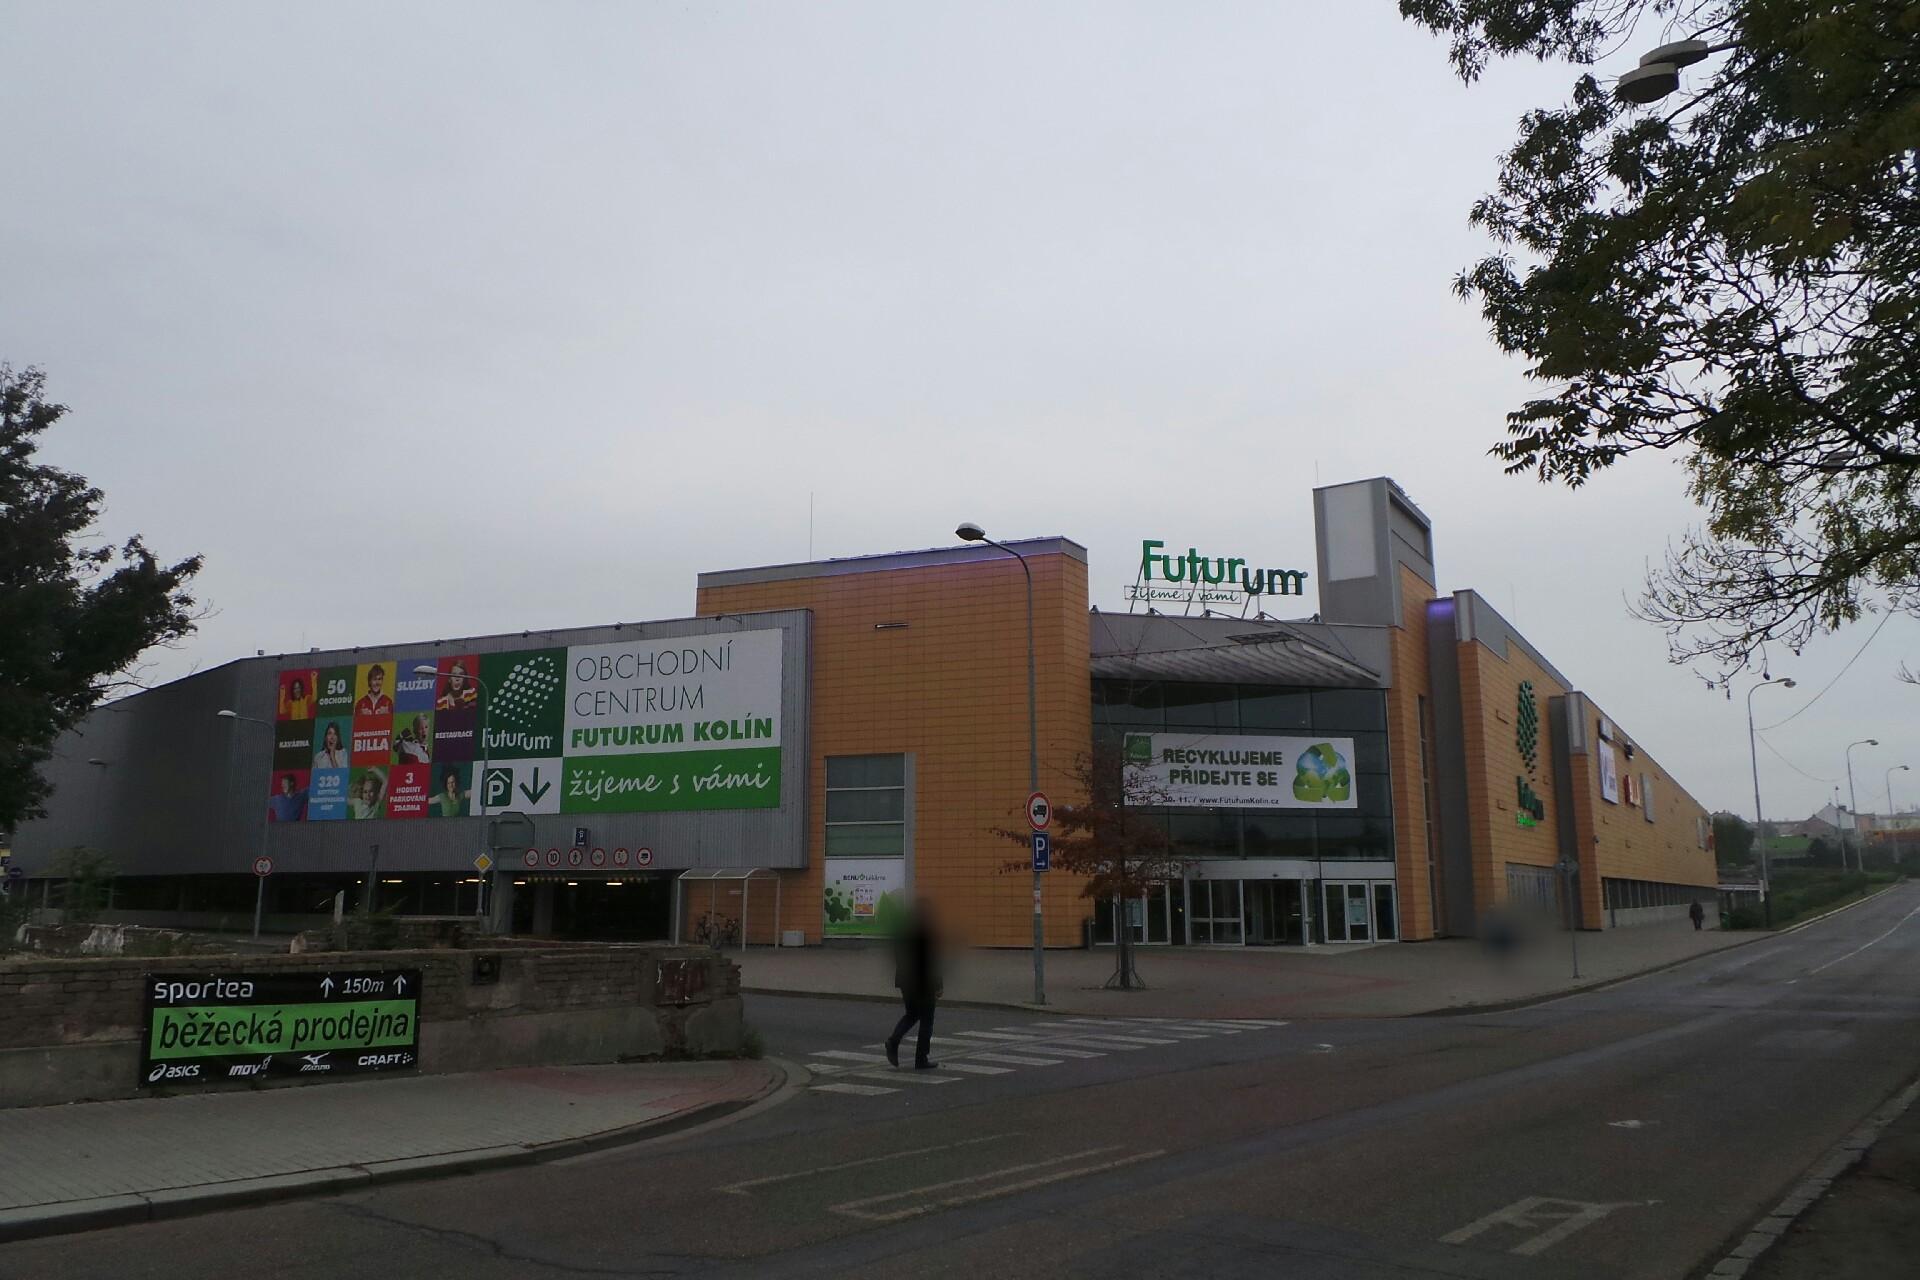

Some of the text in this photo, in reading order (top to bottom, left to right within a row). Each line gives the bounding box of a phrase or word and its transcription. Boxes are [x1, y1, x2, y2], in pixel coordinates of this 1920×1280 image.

[1143, 540, 1303, 595] Futurum
[1130, 585, 1182, 602] žijeme
[1198, 588, 1239, 602] vámi
[576, 640, 733, 681] OBCHODNÍ
[327, 680, 346, 694] 50
[397, 678, 435, 691] SLUŽBY
[319, 694, 353, 705] OBCHODŮ
[574, 684, 704, 716] CENTRUM
[435, 730, 473, 739] RESTAURACE
[482, 728, 550, 750] Futurum
[571, 713, 772, 748] FUTURUM KOLÍN
[353, 738, 389, 752] BILLA
[1163, 748, 1283, 766] RECYKLUJEME
[319, 776, 340, 787] 320
[405, 772, 414, 784] 3
[569, 763, 771, 801] žijeme s vámi
[1169, 766, 1278, 786] PŘIDEJTE SE
[1035, 837, 1046, 859] P
[550, 853, 557, 862] 10
[154, 978, 385, 1003] sportea 150m
[160, 1008, 409, 1049] běžecká prodejna
[358, 1053, 401, 1066] CRAFT
